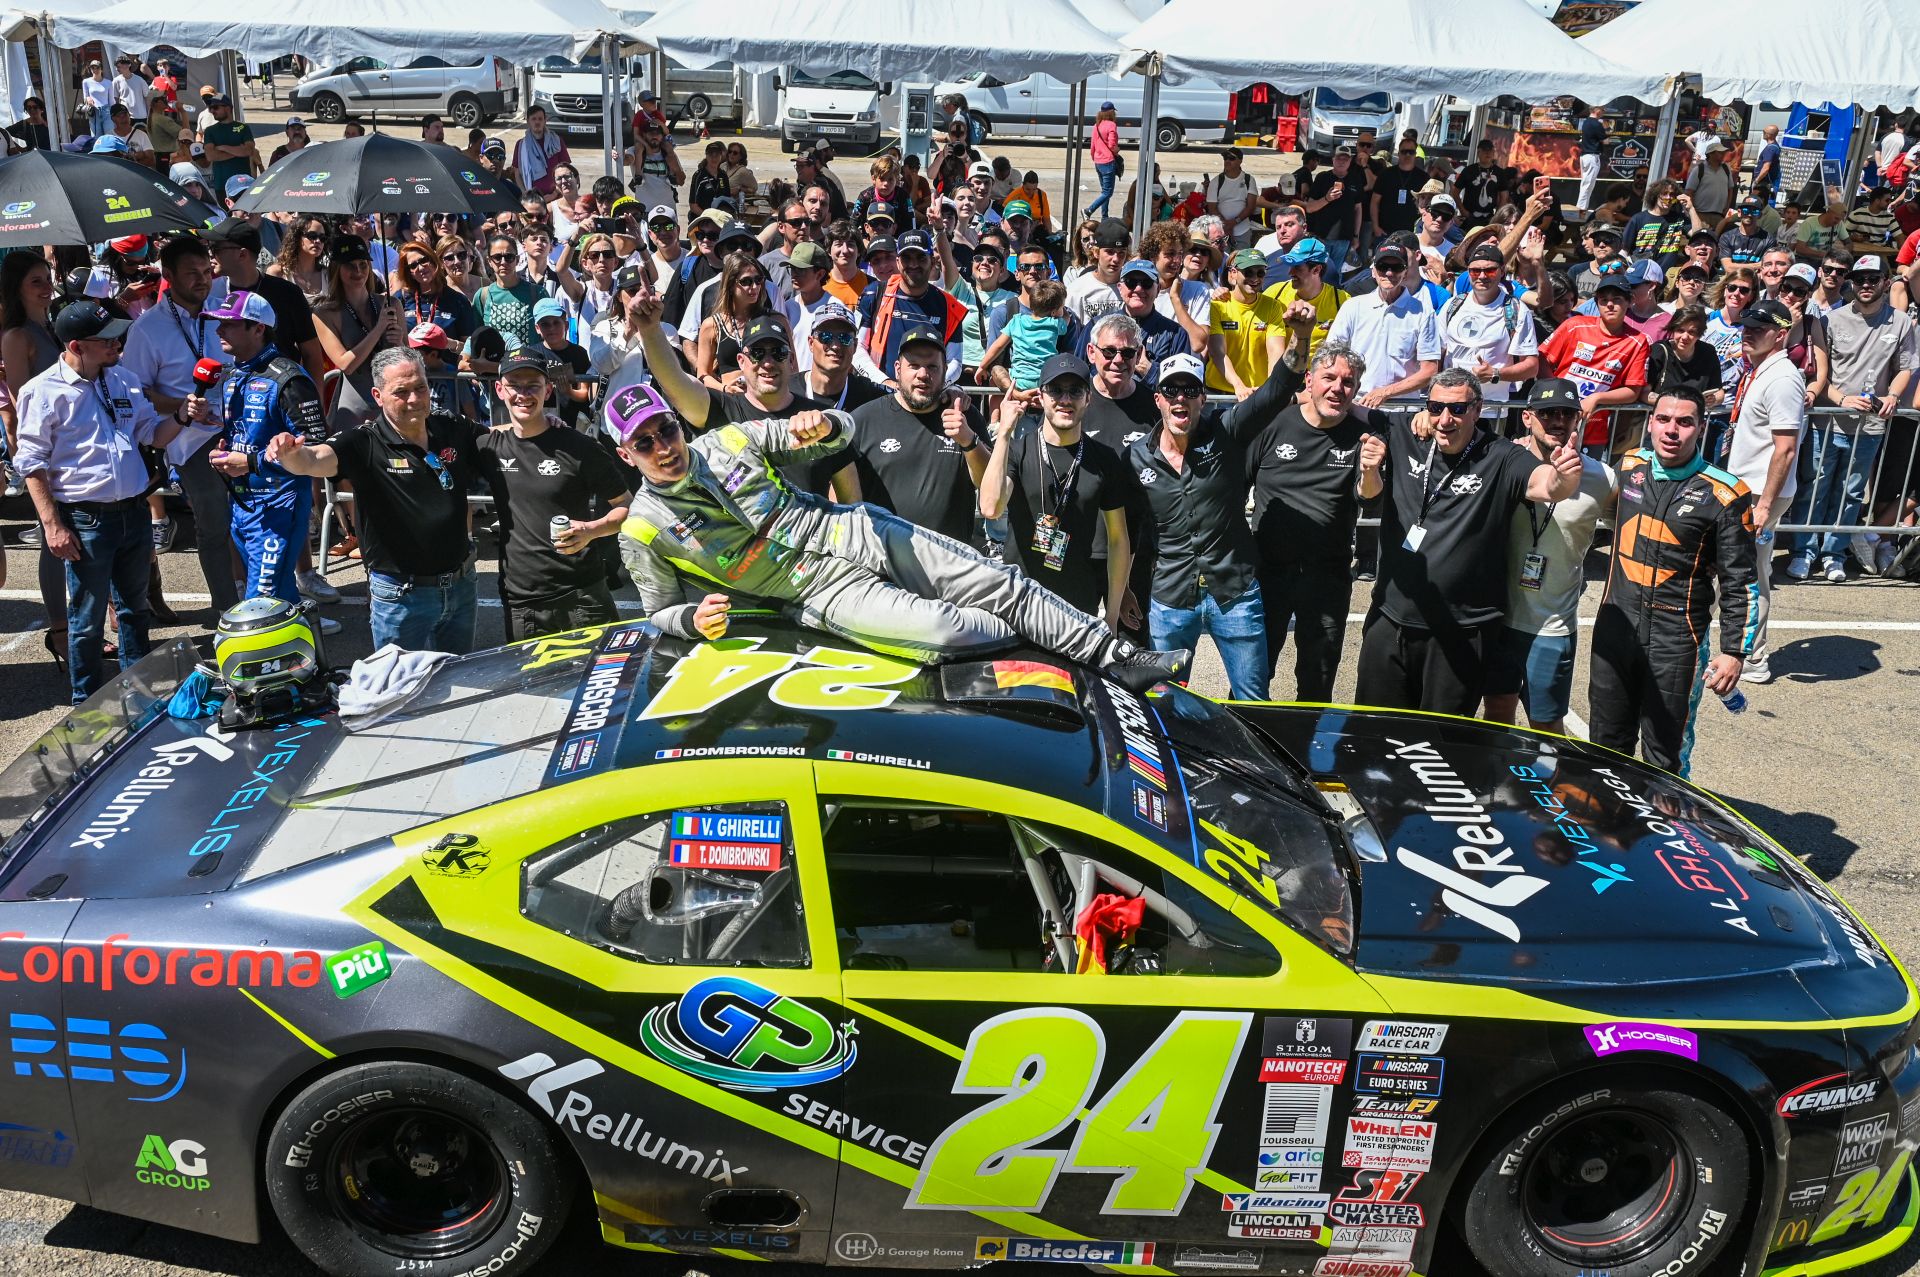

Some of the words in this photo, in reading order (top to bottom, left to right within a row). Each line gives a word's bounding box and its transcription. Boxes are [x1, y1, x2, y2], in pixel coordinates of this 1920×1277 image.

[105, 196, 130, 209] 24
[1163, 360, 1176, 371] 24
[1579, 367, 1613, 382] HONDA
[622, 398, 650, 418] HOOSIER
[521, 629, 604, 671] 24
[261, 659, 281, 674] 24
[637, 637, 924, 721] 24
[569, 667, 623, 734] NASCAR
[1101, 678, 1162, 763] NASCAR
[682, 747, 806, 757] DOMBROWSKI
[855, 753, 931, 770] GHIRELLI
[70, 752, 198, 849] Rellumix
[189, 731, 309, 856] VEXELIS
[1385, 737, 1526, 873] Rellumix
[1510, 765, 1599, 856] VEXELIS
[702, 818, 714, 838] V.
[717, 818, 780, 839] GHIRELLI
[709, 846, 770, 866] DOMBROWSKI
[1199, 818, 1280, 907] 24
[0, 931, 322, 991] Conforama
[333, 944, 385, 989] Più
[677, 975, 835, 1069] GP
[1387, 1027, 1436, 1038] NASCAR
[1617, 1031, 1692, 1050] HOOSIER
[10, 1012, 172, 1086] RES
[1276, 1045, 1332, 1053] STROM
[1369, 1038, 1402, 1048] RACE
[1405, 1040, 1430, 1050] CAR
[1265, 1061, 1343, 1074] NANOTECH
[1386, 1061, 1429, 1073] NASCAR
[1369, 1077, 1395, 1088] EURO
[1396, 1079, 1428, 1091] SERIES
[1782, 1081, 1877, 1112] KENNOL
[298, 1089, 394, 1147] HOOSIER
[903, 1006, 1255, 1216] 24
[1359, 1111, 1424, 1120] ORGANIZATION
[783, 1094, 928, 1164] SERVICE
[1350, 1119, 1433, 1137] WHELEN
[1515, 1088, 1611, 1155] HOOSIER
[556, 1090, 750, 1187] Rellumix
[1263, 1136, 1315, 1145] rousseau
[1352, 1135, 1386, 1143] TRUSTED
[1398, 1138, 1430, 1146] PROTECT
[1846, 1119, 1885, 1144] WRK
[135, 1134, 208, 1177] AG
[1285, 1149, 1324, 1162] aria
[1377, 1143, 1425, 1152] RESPONDERS
[1840, 1139, 1881, 1164] MKT
[1364, 1155, 1430, 1165] SAMSONAS
[136, 1170, 211, 1191] GROUP
[1250, 1197, 1328, 1209] iRacing
[1806, 1150, 1912, 1246] 24
[1331, 1203, 1418, 1216] QUARTER
[1234, 1215, 1307, 1227] LINCOLN
[1345, 1213, 1420, 1225] MASTER
[675, 1230, 789, 1248] VEXELIS
[1249, 1228, 1312, 1238] WELDERS
[1334, 1229, 1413, 1243] ATOMIX-R
[869, 1247, 885, 1256] V8
[889, 1248, 930, 1258] Garage
[933, 1248, 964, 1256] Roma
[1015, 1243, 1115, 1261] Bricofer
[1320, 1261, 1406, 1277] SIMPSON
